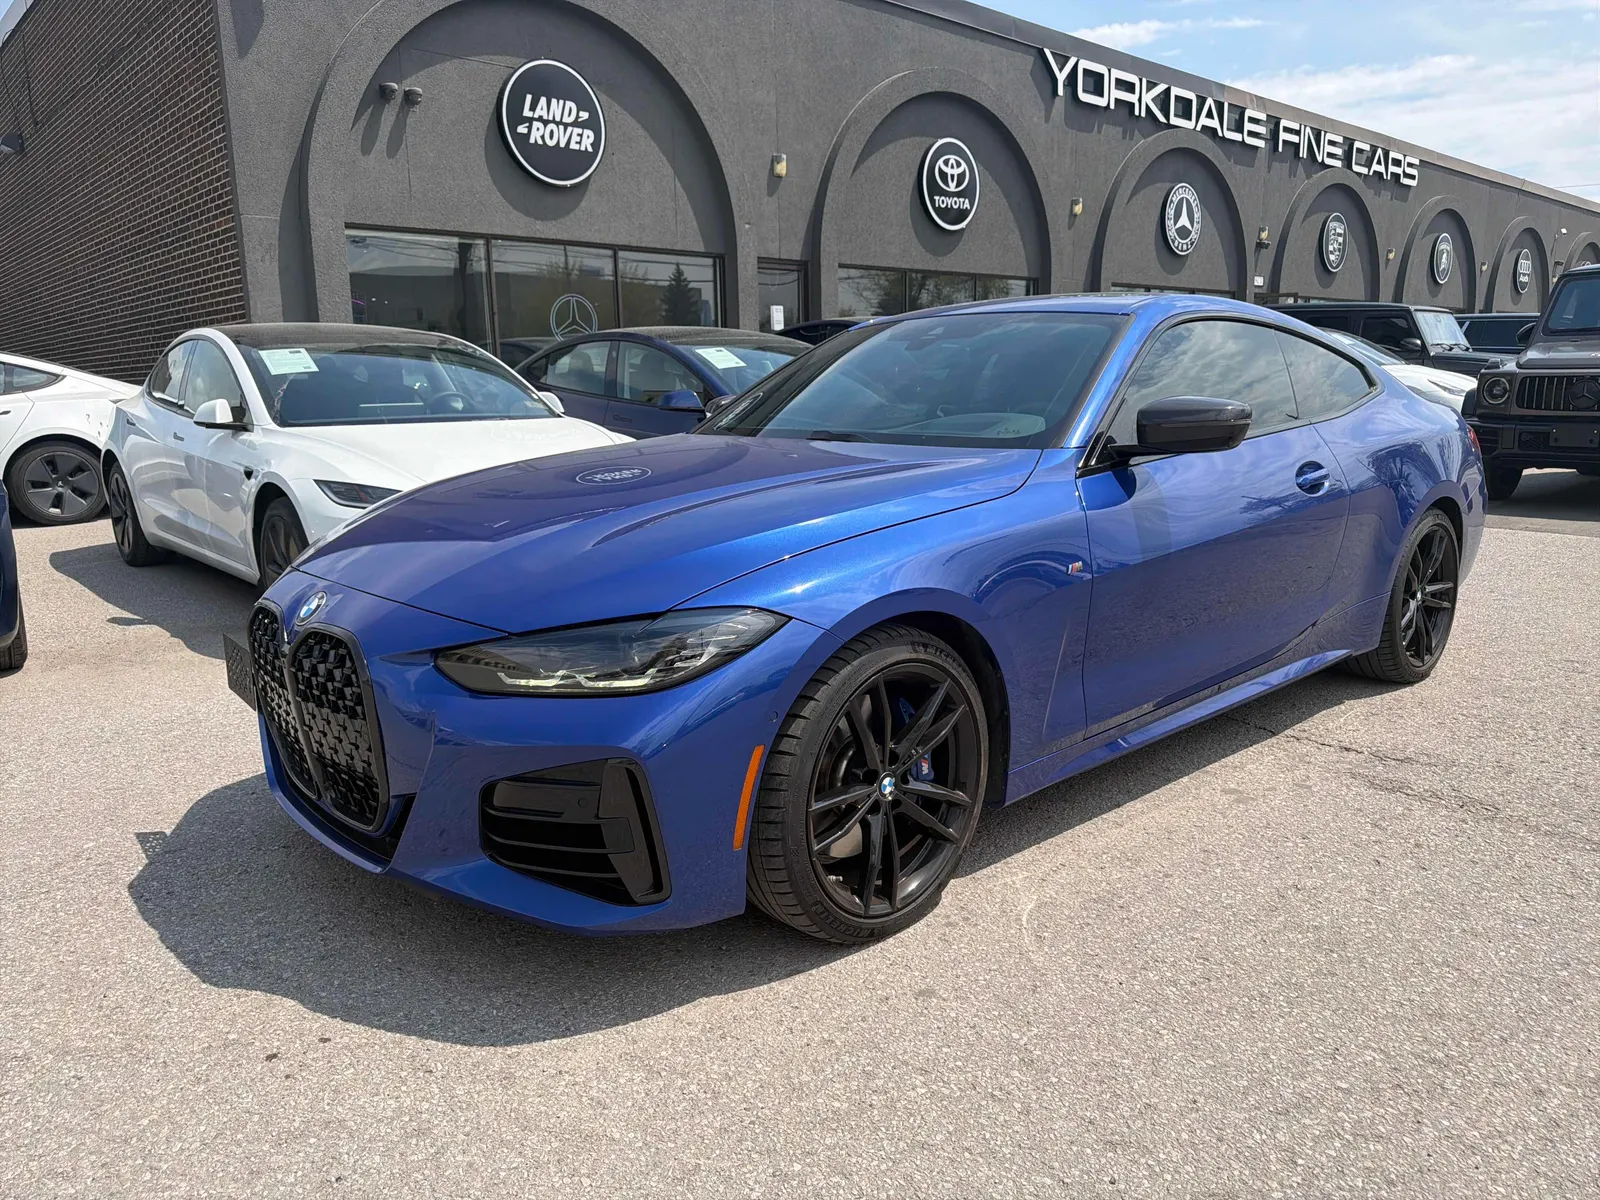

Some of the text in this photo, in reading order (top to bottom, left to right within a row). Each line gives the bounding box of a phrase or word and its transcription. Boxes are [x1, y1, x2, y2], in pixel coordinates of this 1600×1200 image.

[522, 93, 578, 124] LAND
[1043, 47, 1420, 187] YORKDALE FINE CARS
[528, 121, 595, 153] ROVER
[933, 195, 971, 210] TOYOTA
